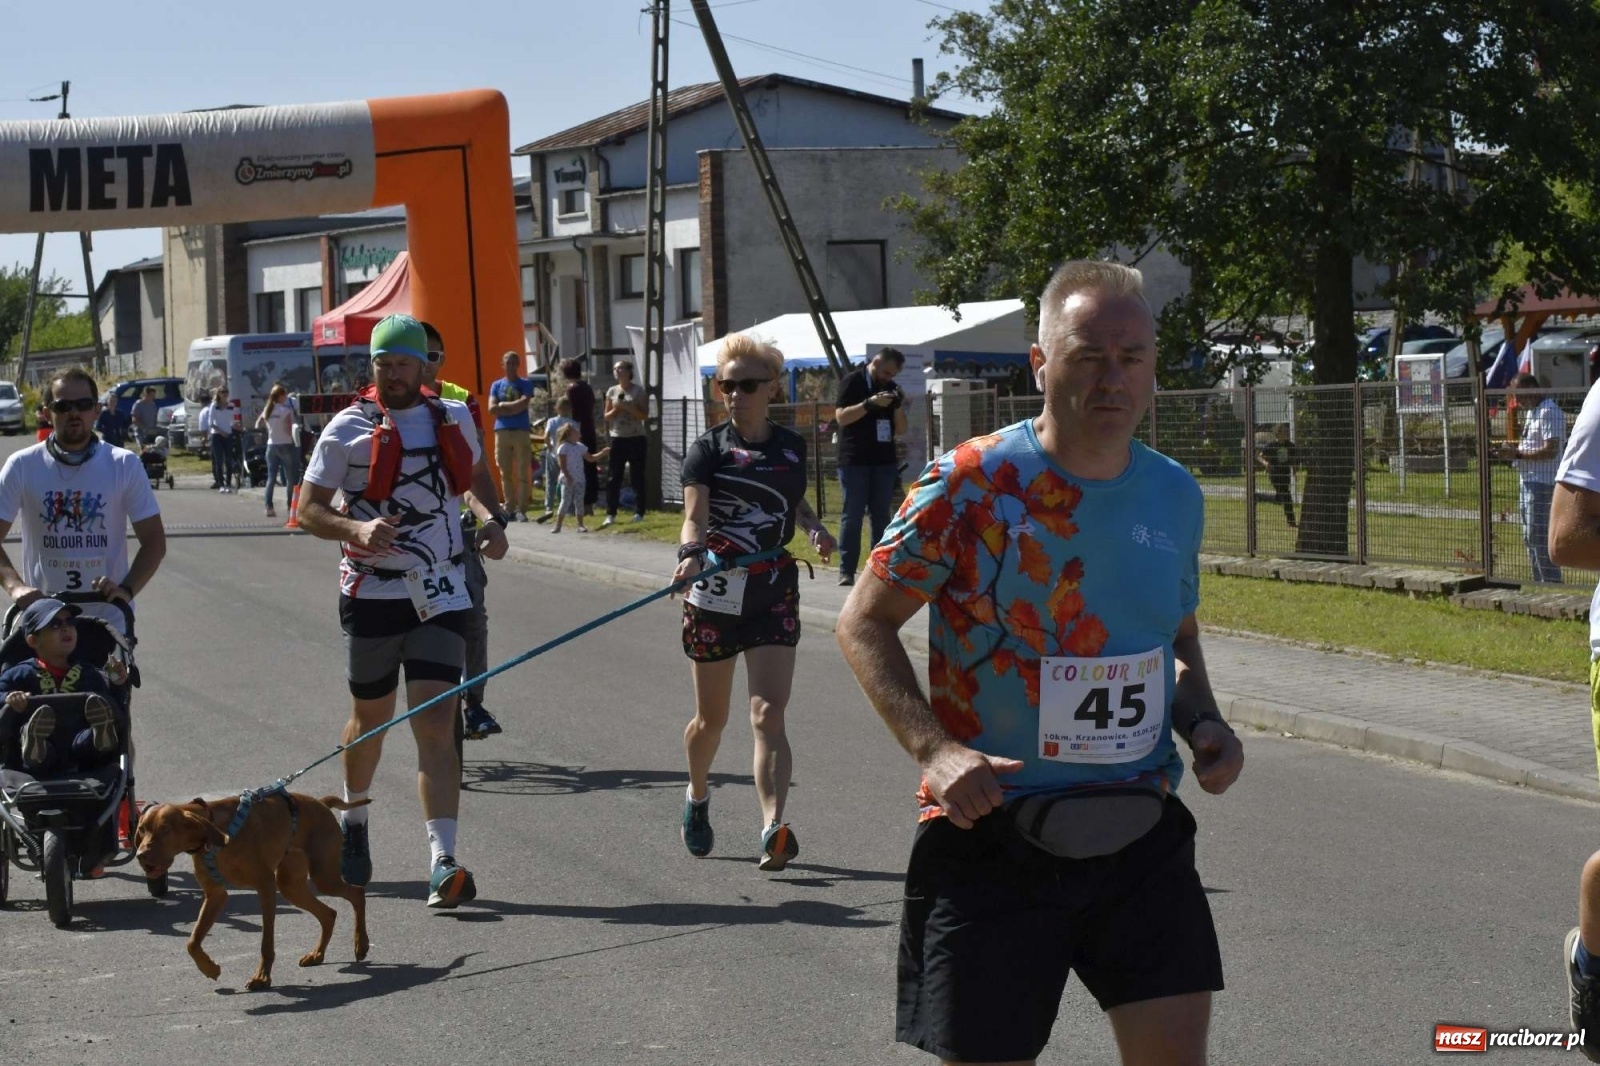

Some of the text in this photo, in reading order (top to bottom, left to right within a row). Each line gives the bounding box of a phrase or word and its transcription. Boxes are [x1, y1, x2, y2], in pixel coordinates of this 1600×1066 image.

[29, 143, 192, 212] META
[43, 534, 108, 548] COLOUR RUN
[66, 571, 82, 590] 3
[423, 576, 455, 599] 54
[1051, 655, 1160, 682] COLOUR RUN
[1074, 683, 1146, 729] 45
[1076, 732, 1129, 742] Krzanowice,
